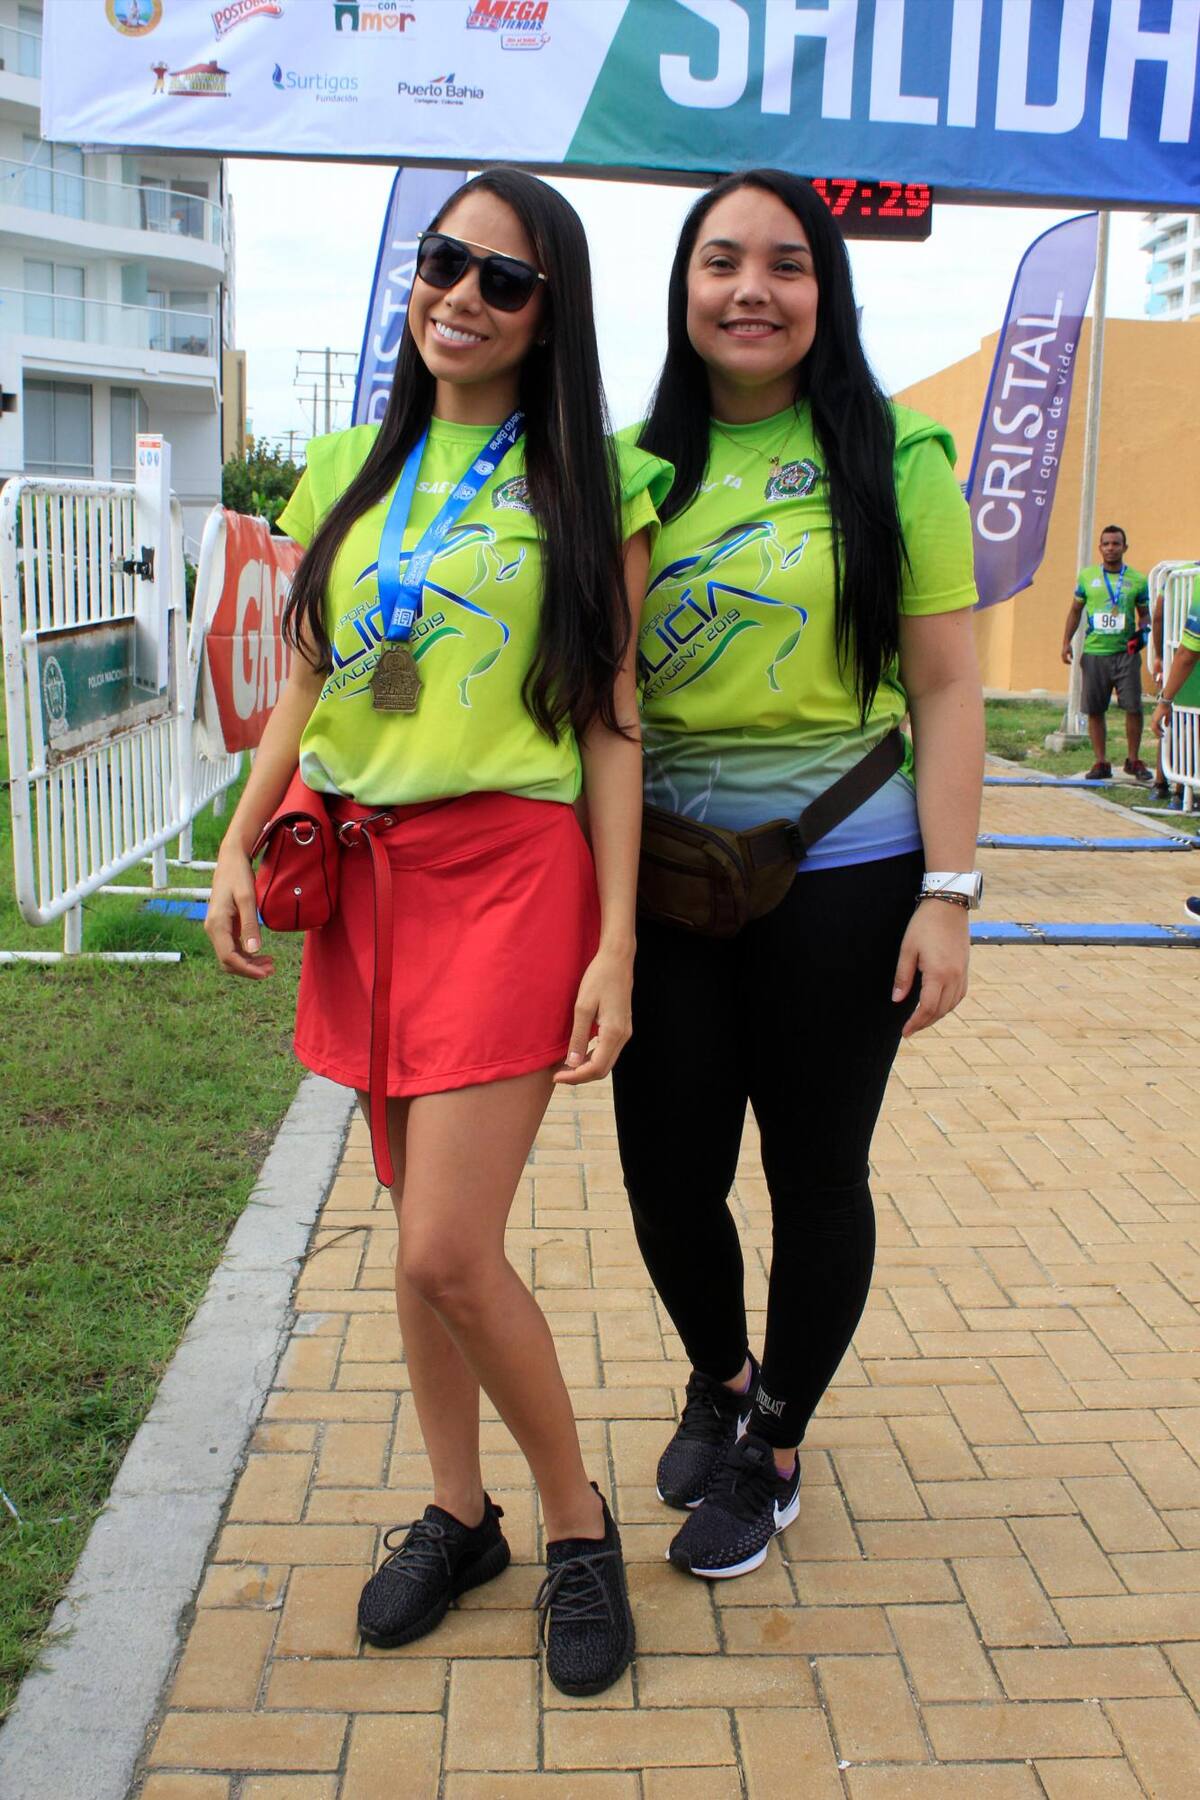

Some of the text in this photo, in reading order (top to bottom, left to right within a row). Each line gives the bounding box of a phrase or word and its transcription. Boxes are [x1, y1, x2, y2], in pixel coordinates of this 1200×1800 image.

[214, 0, 276, 29] POSTOB
[378, 2, 397, 11] con
[474, 0, 549, 22] MEGA
[286, 71, 359, 93] Surtigas
[398, 82, 442, 97] Puerto
[976, 297, 1063, 542] CRISTAL
[1033, 341, 1075, 507] el agua de vida
[409, 611, 445, 642] 2019
[706, 608, 741, 641] 2019
[1102, 614, 1116, 628] 96
